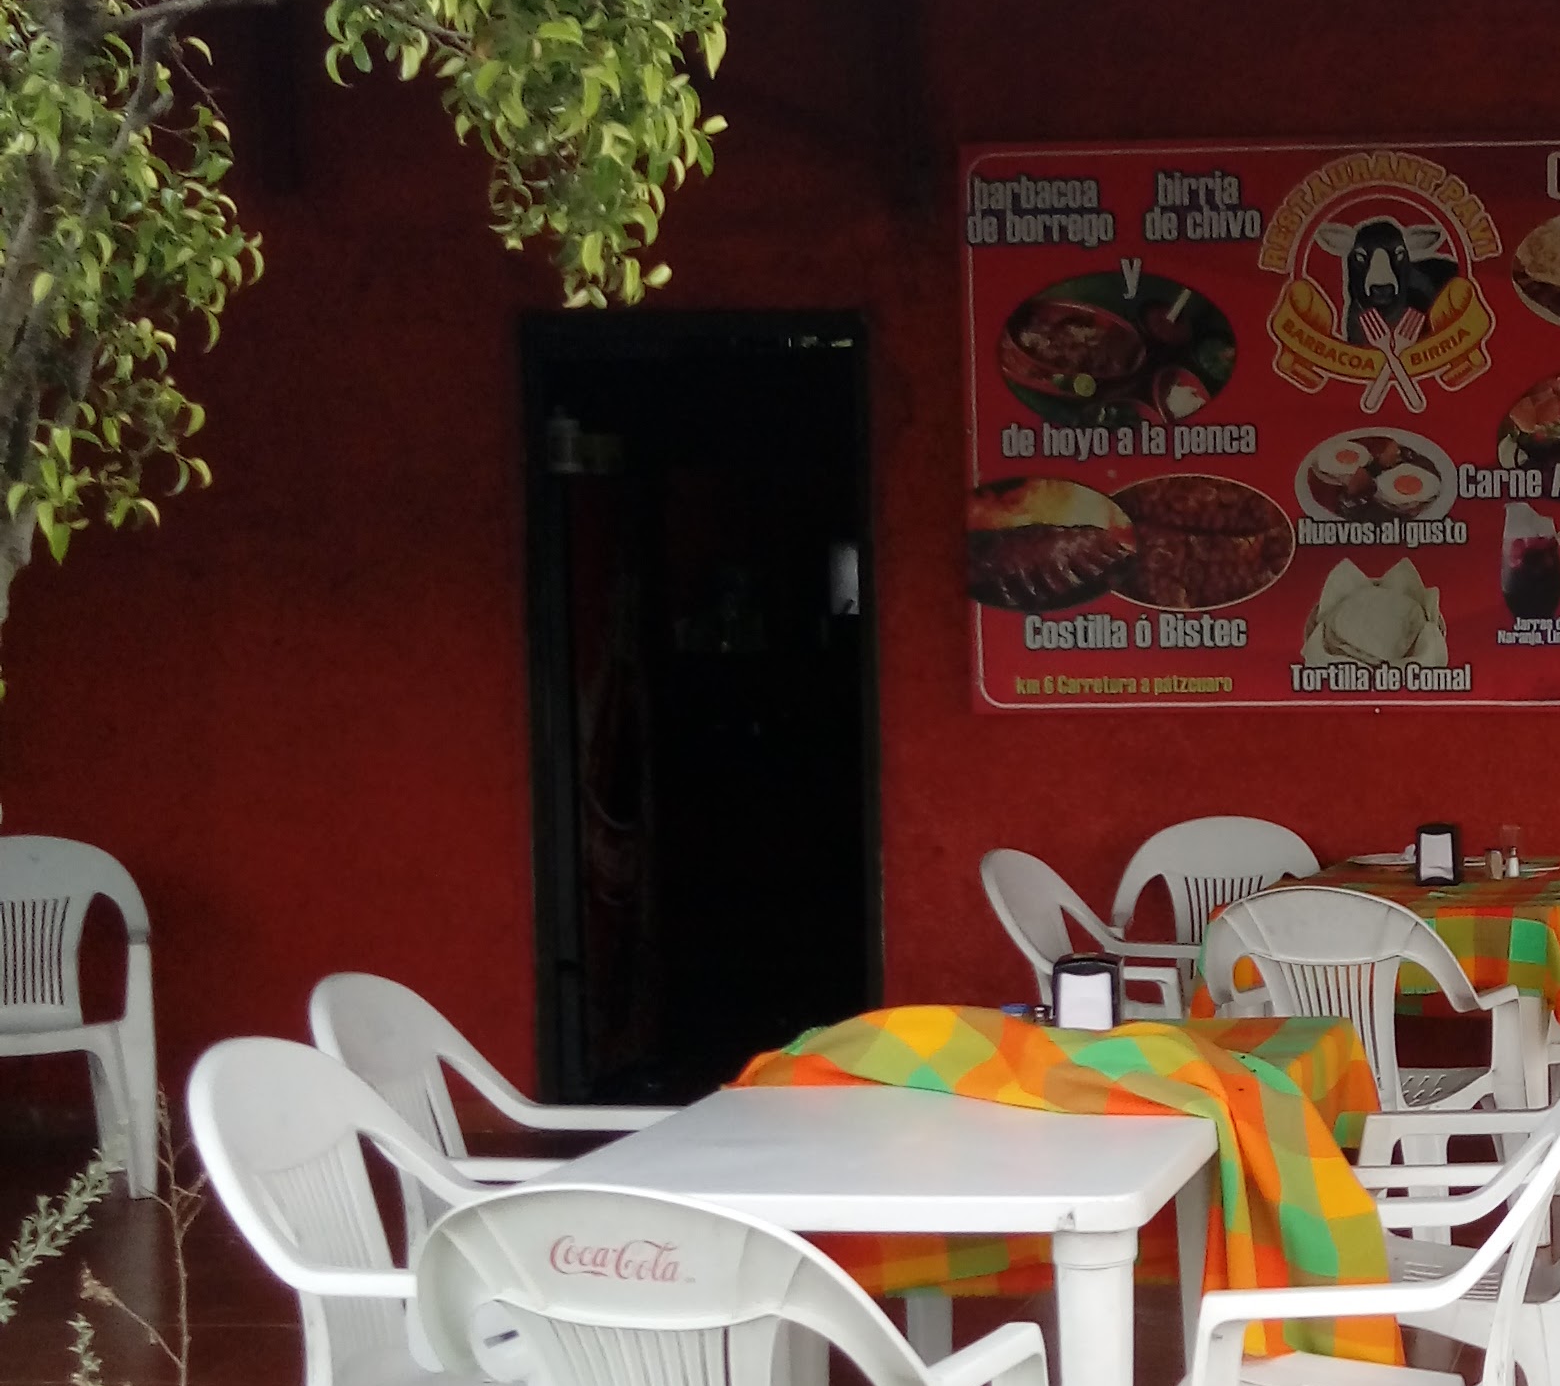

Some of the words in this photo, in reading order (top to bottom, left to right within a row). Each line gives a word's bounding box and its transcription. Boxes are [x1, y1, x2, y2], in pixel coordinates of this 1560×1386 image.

[973, 175, 1098, 210] barbacoa
[1157, 170, 1239, 207] birria
[968, 214, 998, 244] de
[1006, 213, 1114, 248] borrego
[1145, 207, 1178, 241] de
[1186, 208, 1261, 240] chivo
[1120, 258, 1142, 300] y
[1281, 318, 1376, 372] BARBACOA
[1410, 327, 1471, 368] BIRRIA
[1002, 423, 1035, 457] de
[1043, 423, 1109, 461] hoyo
[1117, 427, 1134, 455] a
[1141, 421, 1167, 455] la
[1174, 424, 1257, 460] penca
[1458, 464, 1542, 498] Carne
[1298, 517, 1377, 544] Huevos
[1382, 517, 1400, 544] al
[1406, 518, 1467, 548] gusto
[1025, 615, 1128, 649] Costilla
[1135, 615, 1152, 647] ó
[1159, 613, 1248, 647] Bistec
[1291, 663, 1370, 691] Tortilla
[1376, 663, 1400, 691] de
[1405, 663, 1471, 691] Comal
[549, 1234, 679, 1283] Coca-Cola
